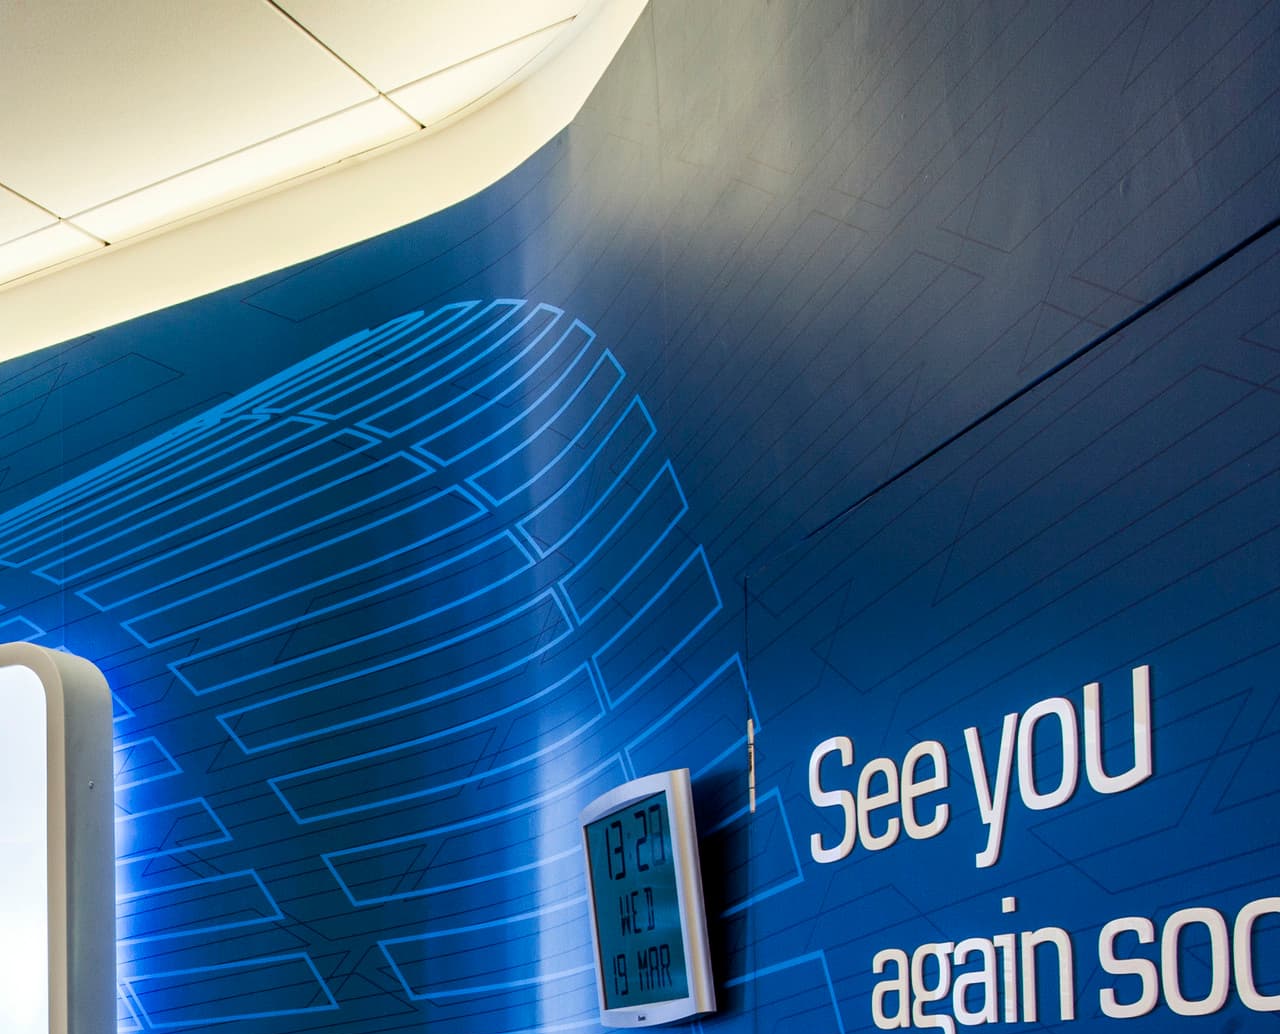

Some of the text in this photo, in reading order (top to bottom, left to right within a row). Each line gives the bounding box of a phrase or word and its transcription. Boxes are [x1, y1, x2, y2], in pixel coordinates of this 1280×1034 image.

[808, 664, 1153, 868] See you
[619, 886, 656, 936] WED
[613, 944, 672, 996] 19 MAR
